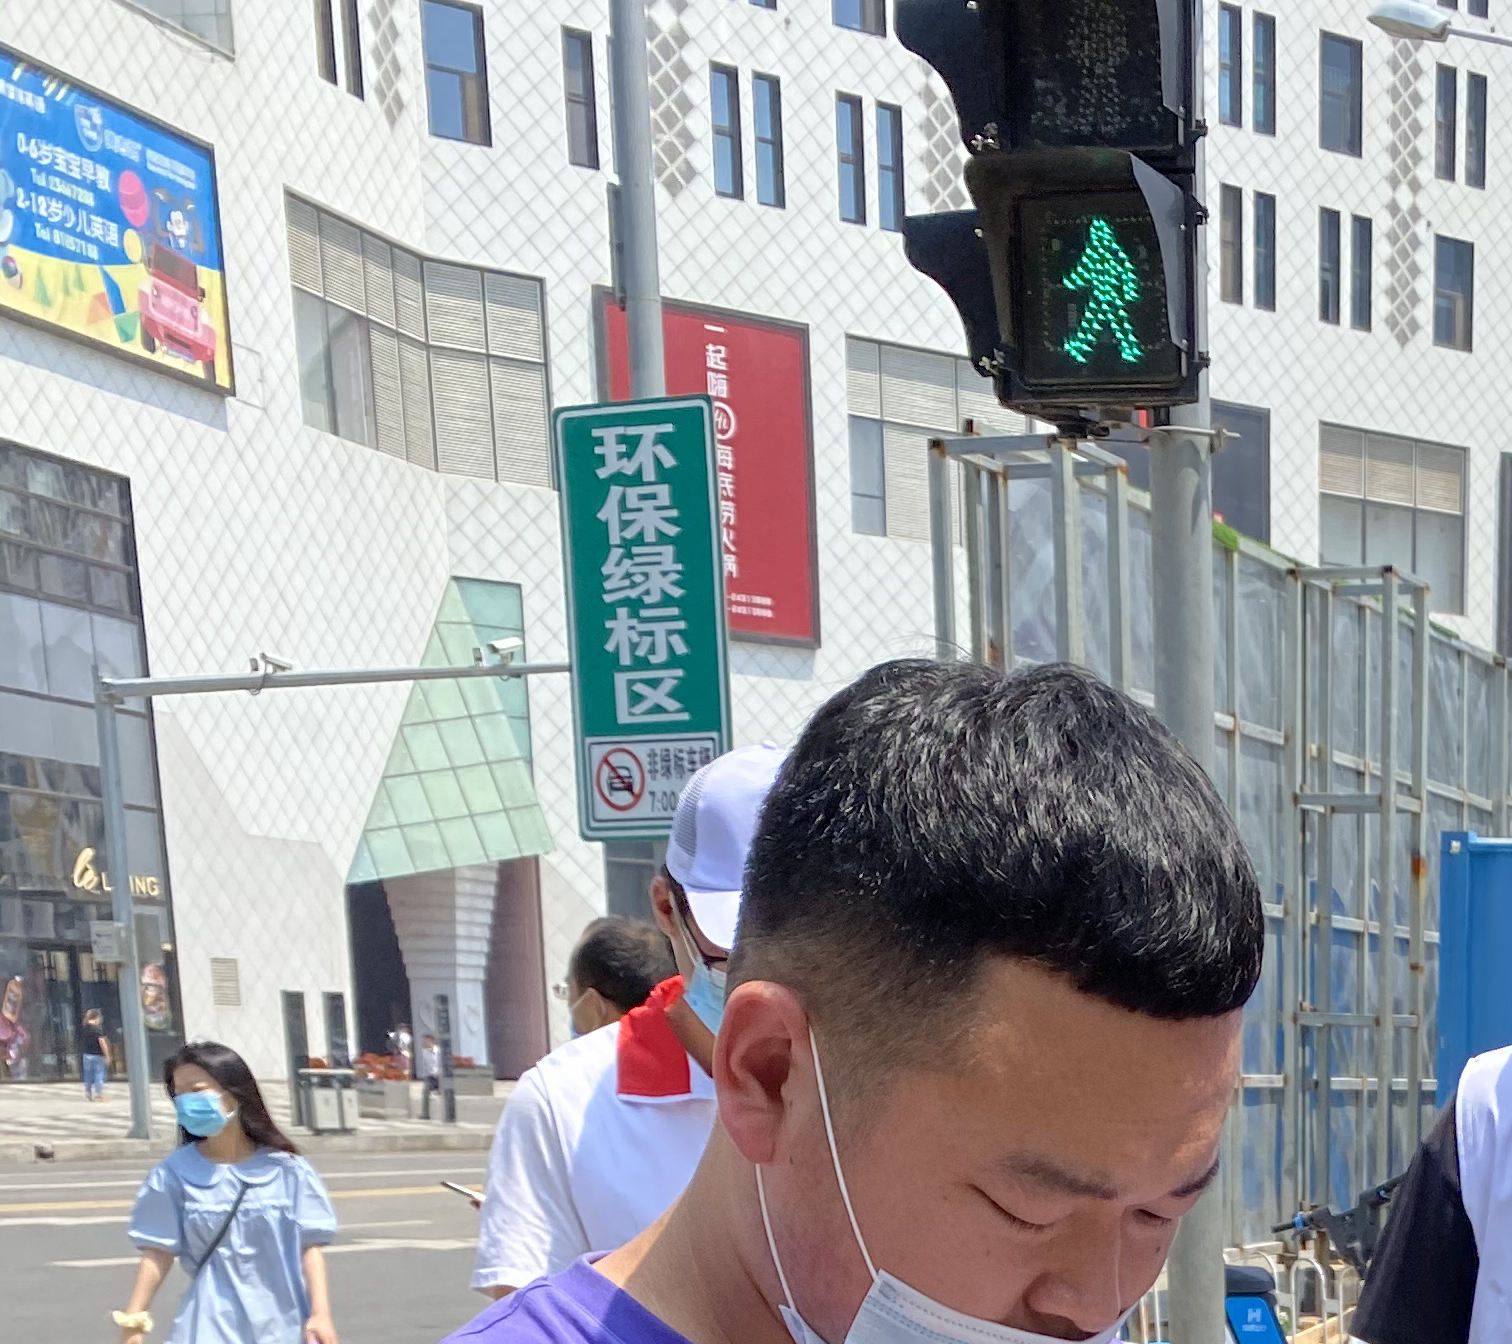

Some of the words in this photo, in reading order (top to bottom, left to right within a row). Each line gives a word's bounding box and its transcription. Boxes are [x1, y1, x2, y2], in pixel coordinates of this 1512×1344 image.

[591, 422, 692, 725] 环保绿标区
[103, 874, 160, 896] LING
